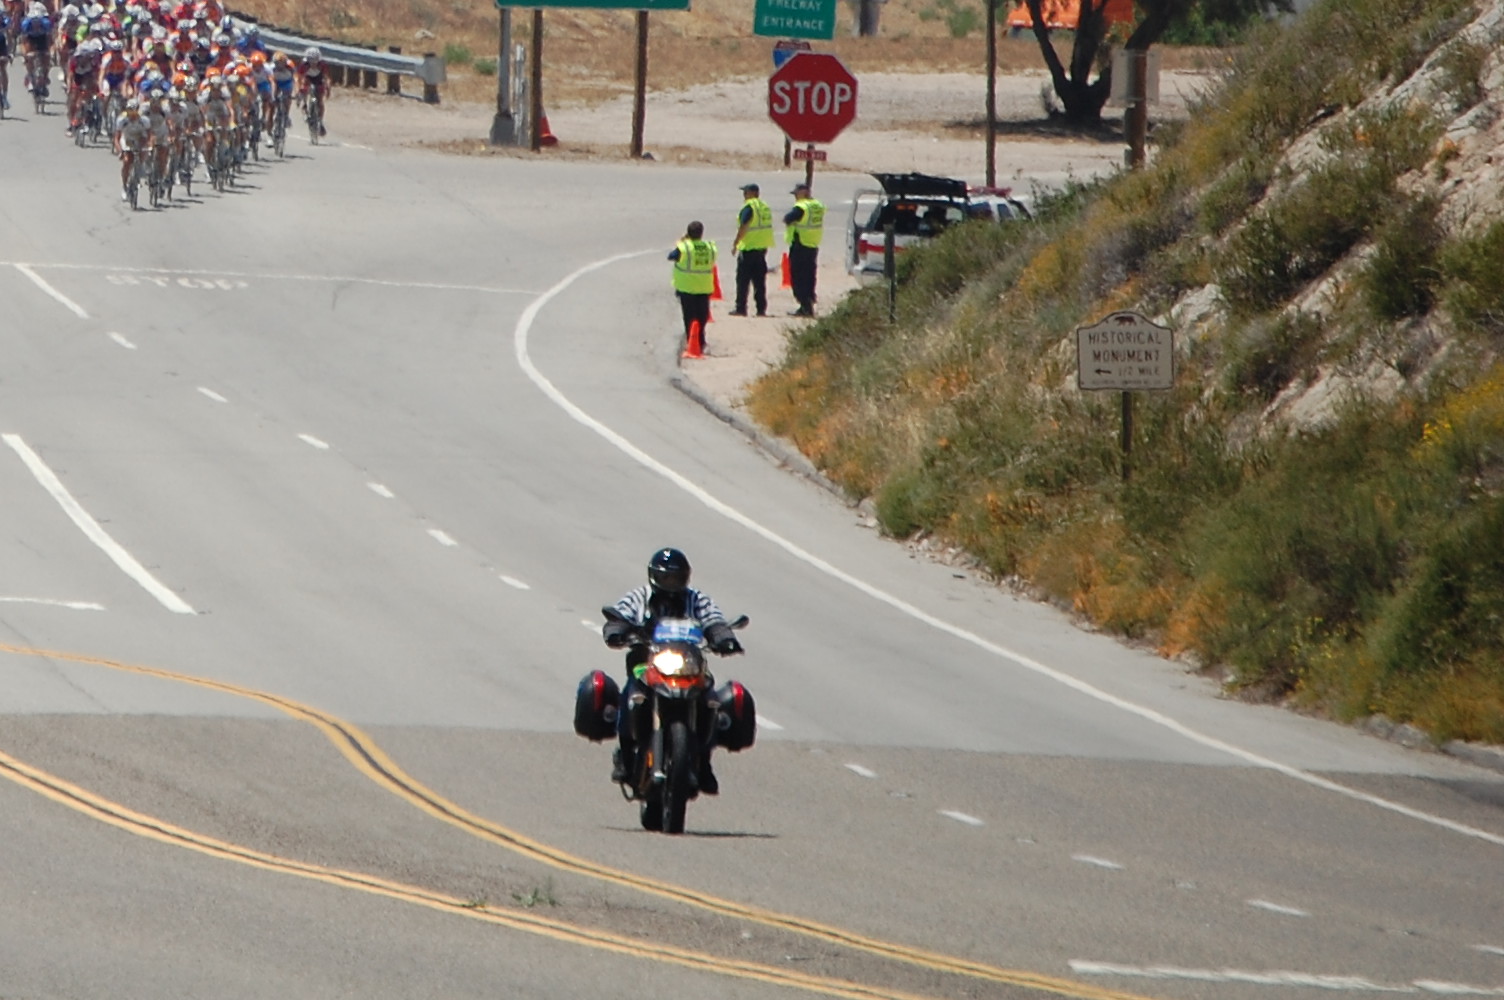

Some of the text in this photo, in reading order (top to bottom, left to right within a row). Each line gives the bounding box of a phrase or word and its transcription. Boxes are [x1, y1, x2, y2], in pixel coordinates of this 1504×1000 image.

[762, 16, 825, 31] ENTRANCE
[772, 79, 852, 116] STOP
[1088, 330, 1162, 345] HISTORICAL
[1092, 350, 1160, 363] MONUMENT
[1118, 366, 1160, 377] 1/2 MILE
